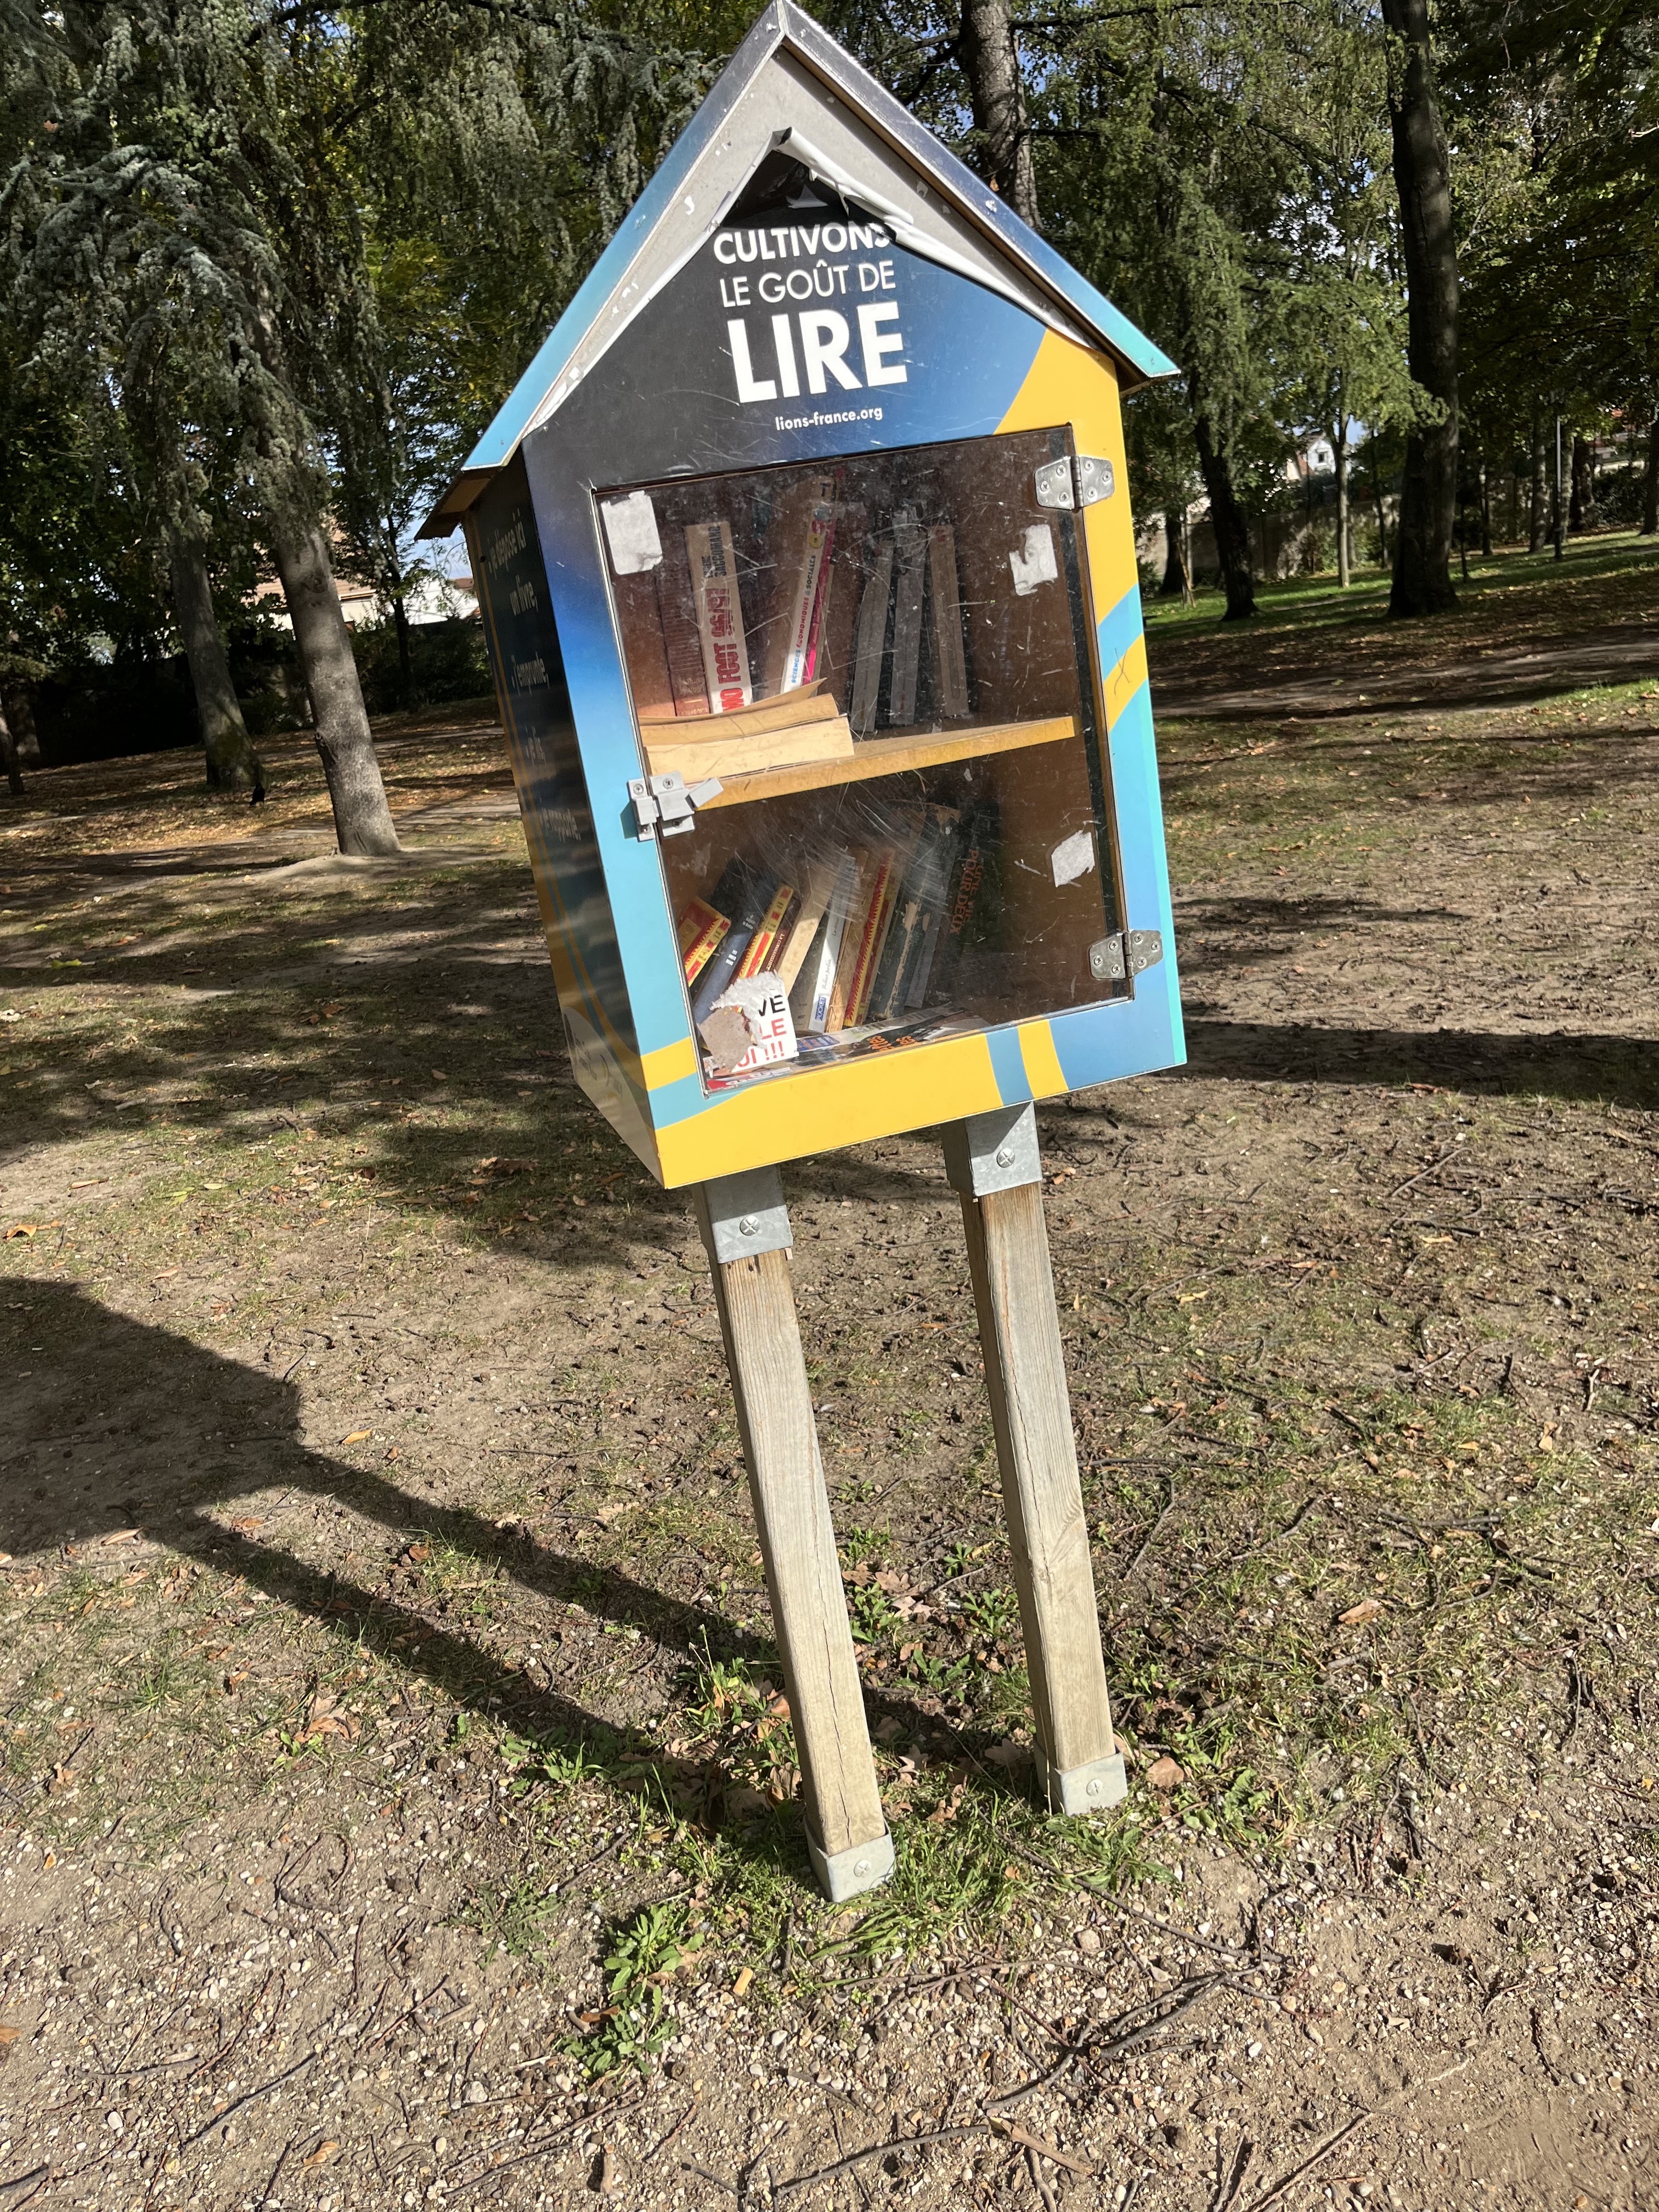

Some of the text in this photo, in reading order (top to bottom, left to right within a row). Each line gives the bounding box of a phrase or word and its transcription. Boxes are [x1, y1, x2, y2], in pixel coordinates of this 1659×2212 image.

[720, 259, 896, 307] LE GOÛT DE
[727, 301, 907, 403] LIRE
[775, 407, 883, 431] lions-france.org
[792, 650, 801, 684] SCIENCES
[806, 555, 816, 589] SOCIALES
[714, 643, 741, 684] FOOT
[950, 848, 979, 935] POUR DEUX
[816, 996, 826, 1021] POCKET
